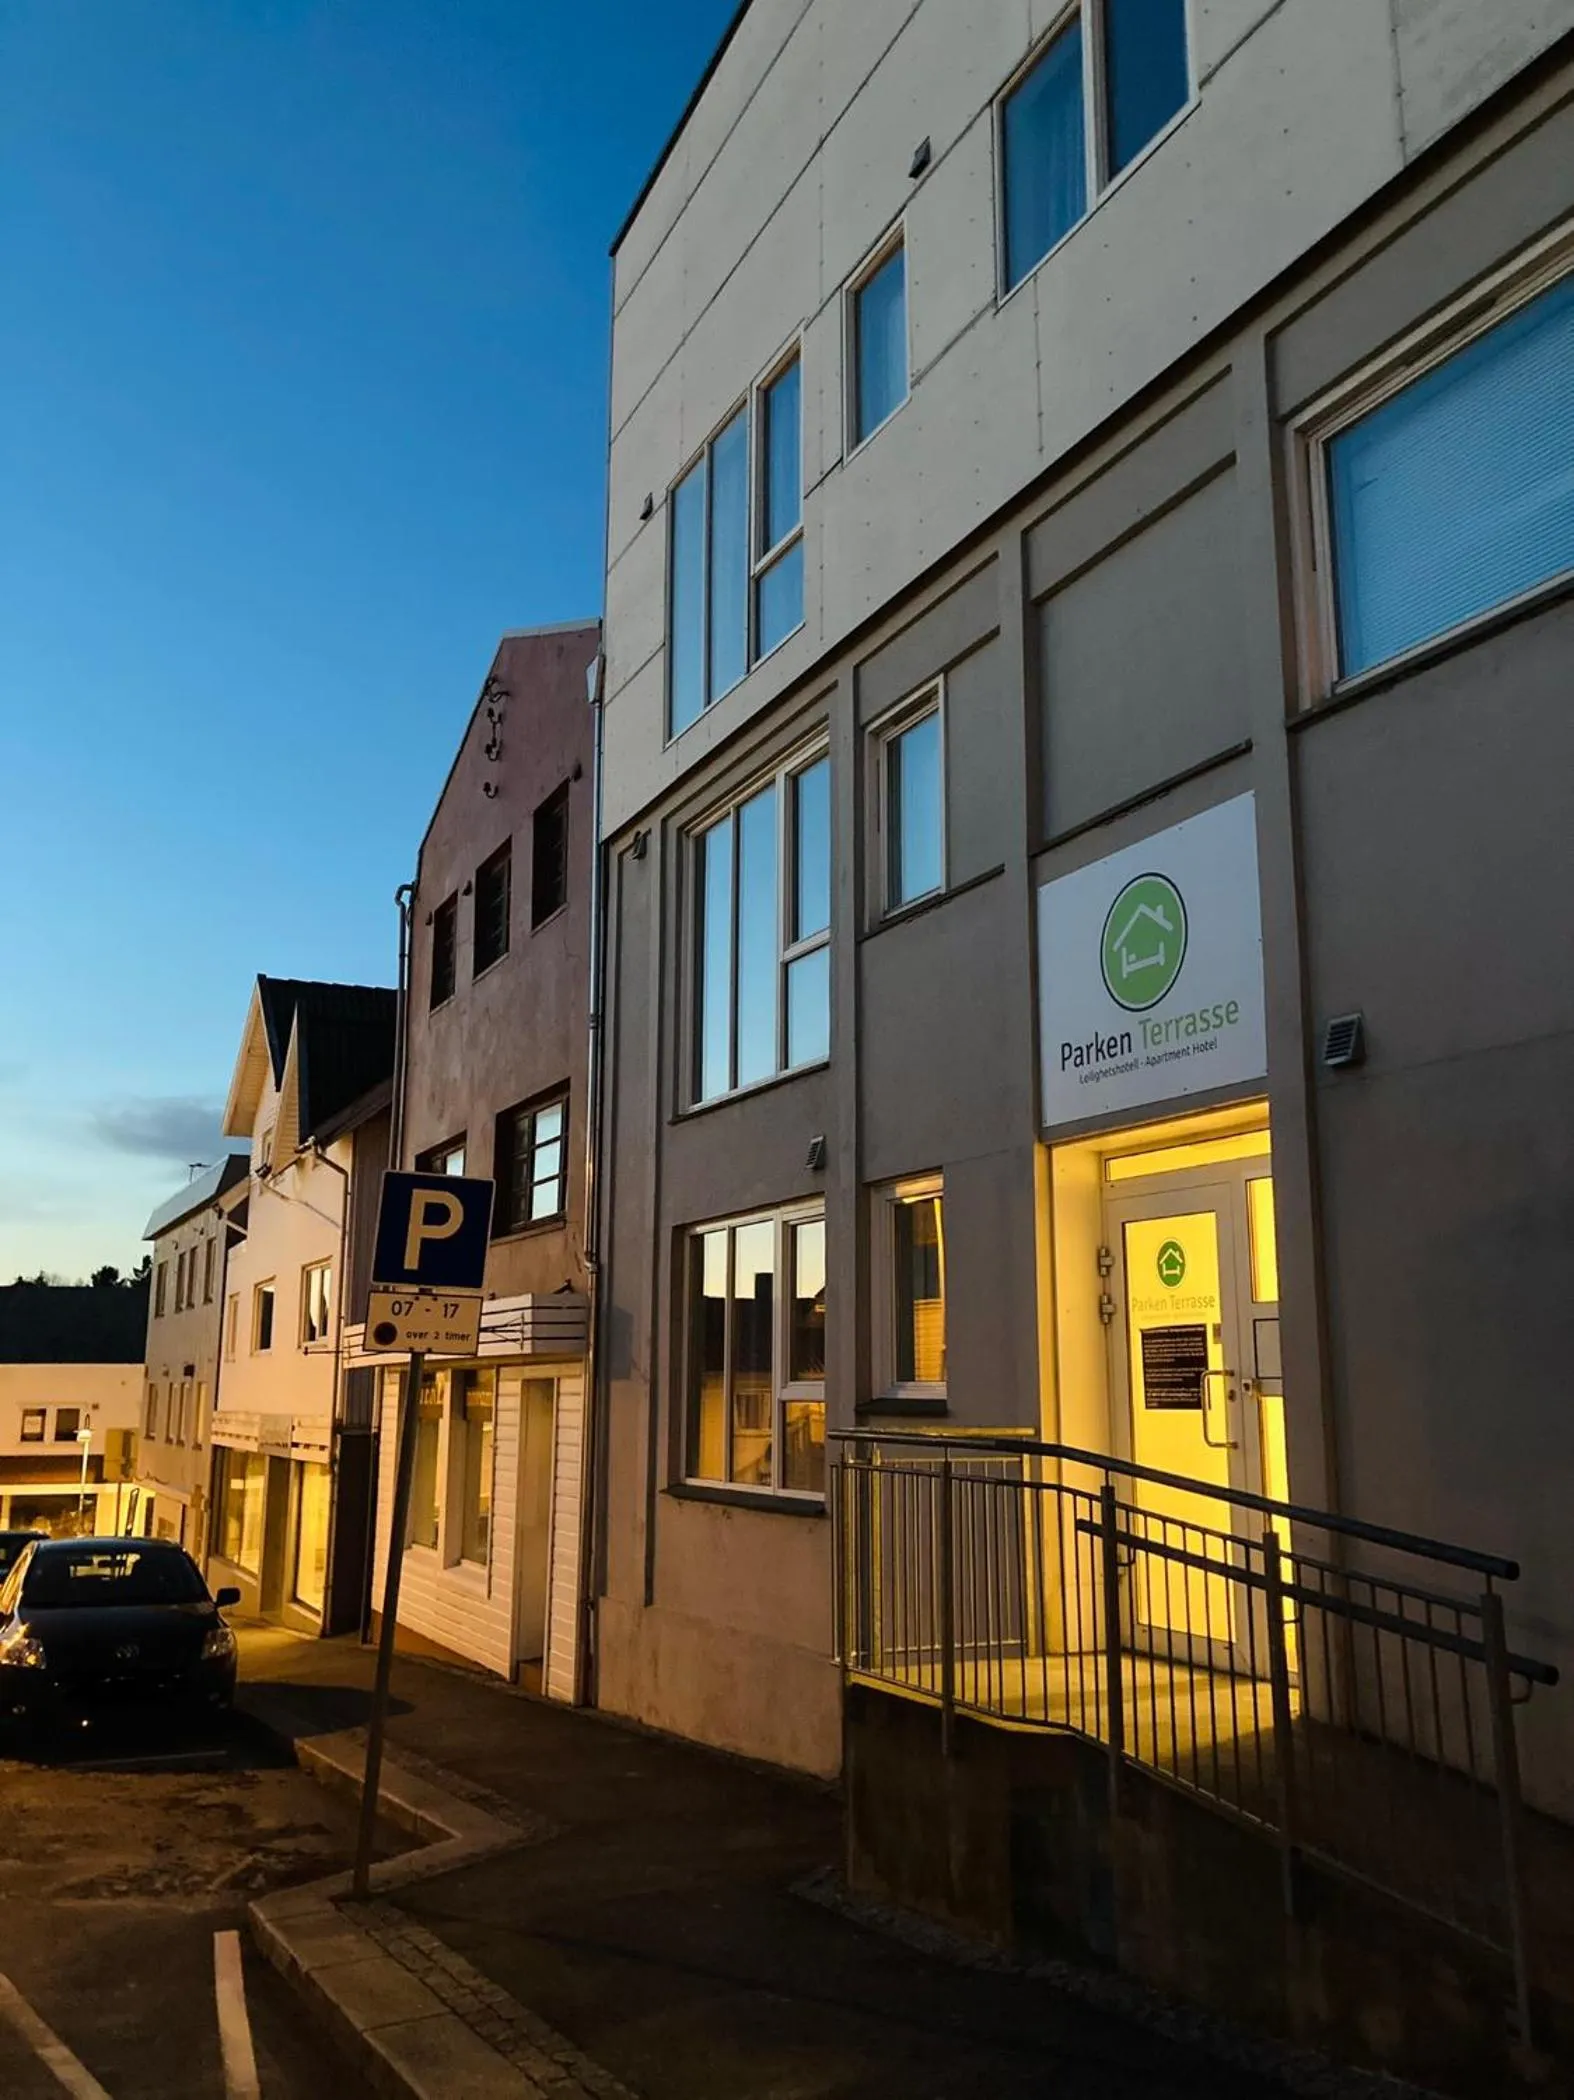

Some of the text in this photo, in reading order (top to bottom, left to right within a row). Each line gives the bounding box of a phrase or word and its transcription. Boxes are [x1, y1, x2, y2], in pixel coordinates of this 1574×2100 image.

[1060, 1000, 1240, 1072] Parken Terrasse
[1079, 1057, 1140, 1085] Leilighetshotell
[1145, 1046, 1191, 1068] Apartment
[1192, 1036, 1218, 1056] Hotel
[403, 1188, 464, 1271] P
[391, 1300, 414, 1317] 07
[443, 1303, 460, 1319] 17
[1131, 1294, 1216, 1313] Parken Terrasse
[405, 1330, 472, 1342] over 2 timer
